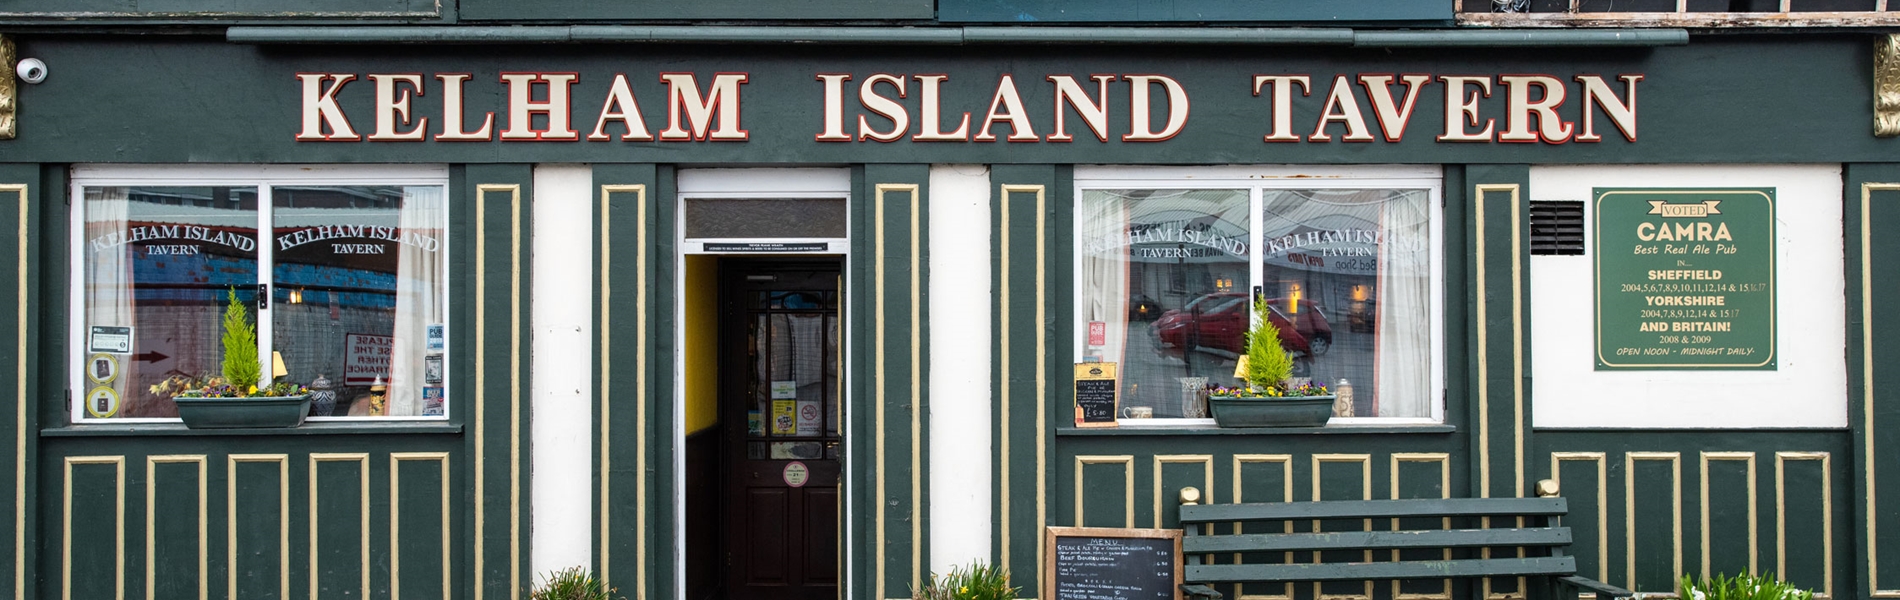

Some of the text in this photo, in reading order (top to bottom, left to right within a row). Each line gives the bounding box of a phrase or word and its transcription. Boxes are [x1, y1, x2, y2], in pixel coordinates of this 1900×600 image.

[295, 71, 1645, 144] KELHAM ISLAND TAVERN
[1663, 205, 1707, 216] VOTED
[1636, 221, 1733, 242] CAMRA
[91, 225, 256, 253] KELHAM ISLAND
[277, 224, 439, 253] KELHAM ISLAND
[1087, 228, 1172, 254] KELHAM
[1177, 229, 1248, 255] ISLAND
[1270, 229, 1350, 254] KELHAM
[145, 244, 199, 255] TAVERN
[331, 243, 385, 254] TAVERN
[1140, 247, 1192, 258] TAVERN
[1320, 246, 1372, 257] TAVERN
[1633, 243, 1737, 255] Best Real Ale Pub
[1648, 269, 1722, 280] SHEFFIELD
[1621, 283, 1727, 293] 2004,5,6,7,8,9,10,11,12,14
[1728, 283, 1737, 292] &
[1645, 296, 1725, 306] YORKSHIRE
[1640, 309, 1708, 319] 2004,7,8,9,12,14
[1709, 309, 1718, 319] &
[1639, 321, 1731, 332] AND BRITAIN!
[1659, 335, 1712, 344] 2008 & 2009
[1616, 347, 1641, 356] OPEN
[1643, 347, 1671, 356] NOON
[1680, 347, 1725, 356] MIDNIGHT
